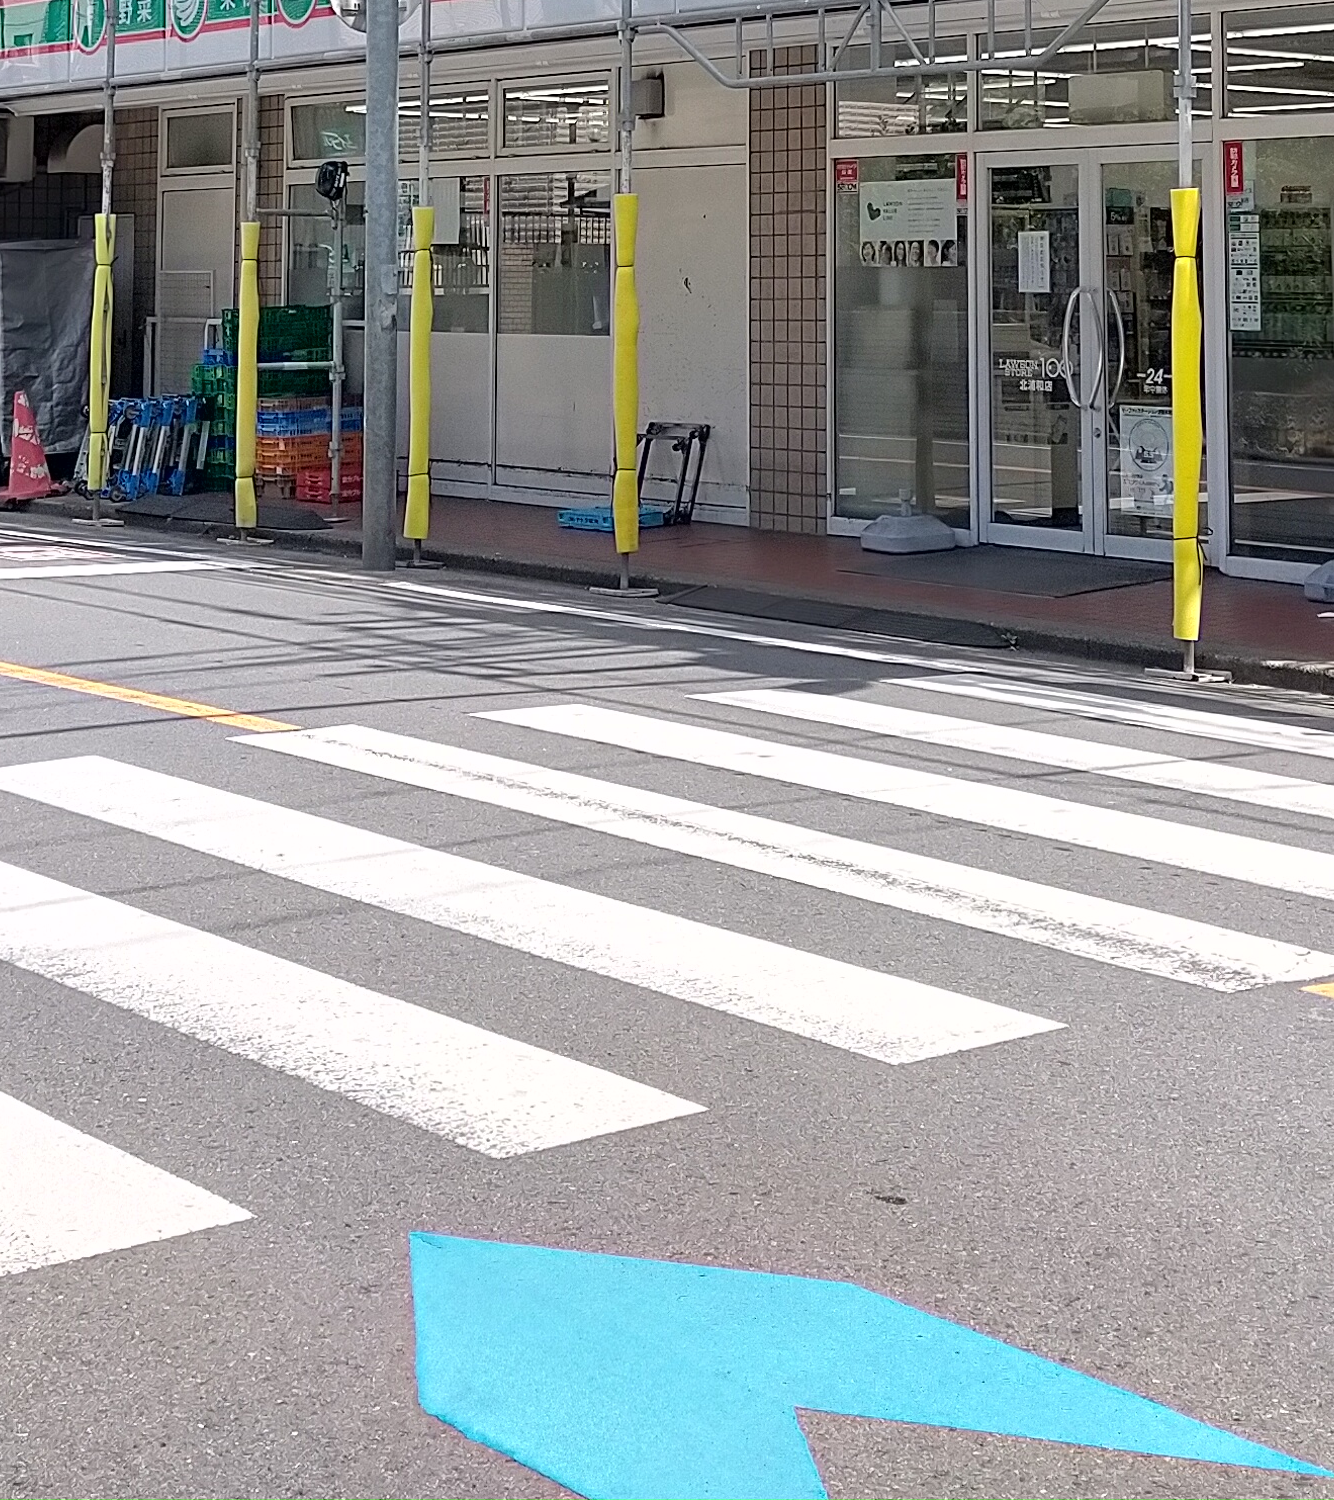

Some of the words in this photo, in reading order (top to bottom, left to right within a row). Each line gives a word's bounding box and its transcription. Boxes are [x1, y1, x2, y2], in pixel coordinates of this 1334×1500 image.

[998, 358, 1039, 370] LAWSON
[1004, 367, 1033, 377] STORE
[1019, 379, 1053, 392] 北浦和店
